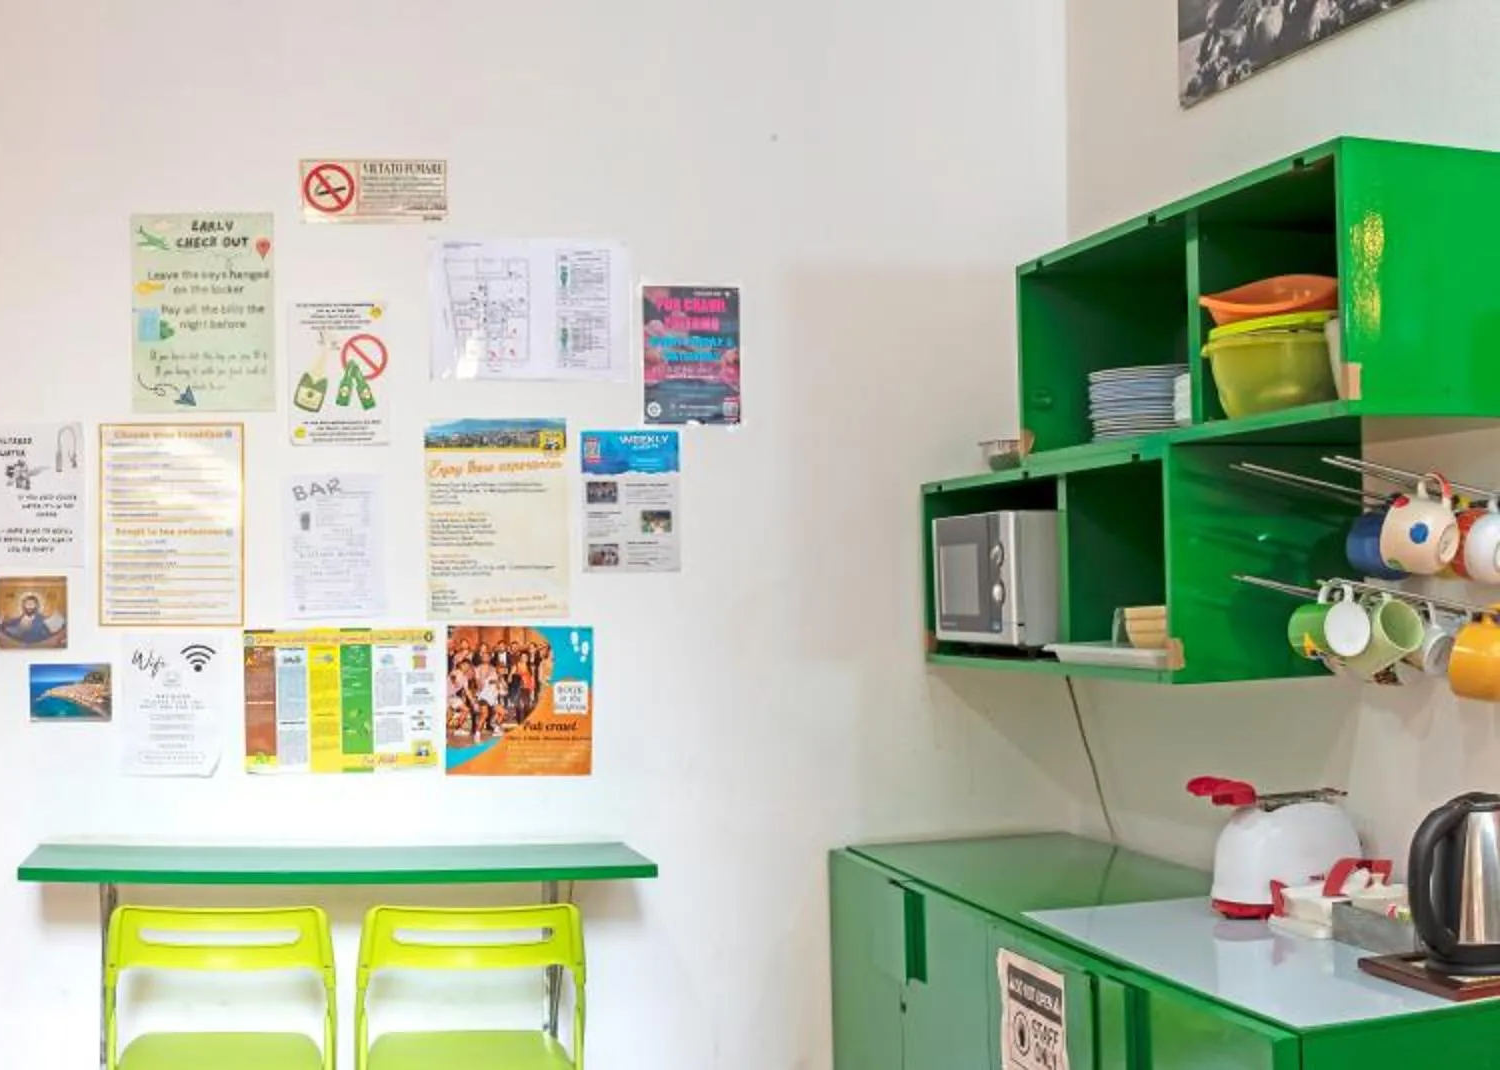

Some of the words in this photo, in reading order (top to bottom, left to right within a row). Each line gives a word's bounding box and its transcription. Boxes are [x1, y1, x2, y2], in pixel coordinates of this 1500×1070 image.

[404, 162, 443, 175] FUMARE
[191, 219, 235, 233] EARLY
[176, 237, 217, 249] CHECK
[223, 236, 249, 248] OUT
[148, 271, 179, 281] Leave
[230, 269, 270, 283] hanged
[161, 304, 181, 316] Pay
[201, 304, 218, 314] the
[247, 304, 265, 314] the
[210, 320, 247, 330] before
[620, 434, 670, 445] WEEKLY
[0, 449, 26, 457] WATER
[291, 476, 342, 501] BAR
[1031, 1018, 1059, 1045] STAFF
